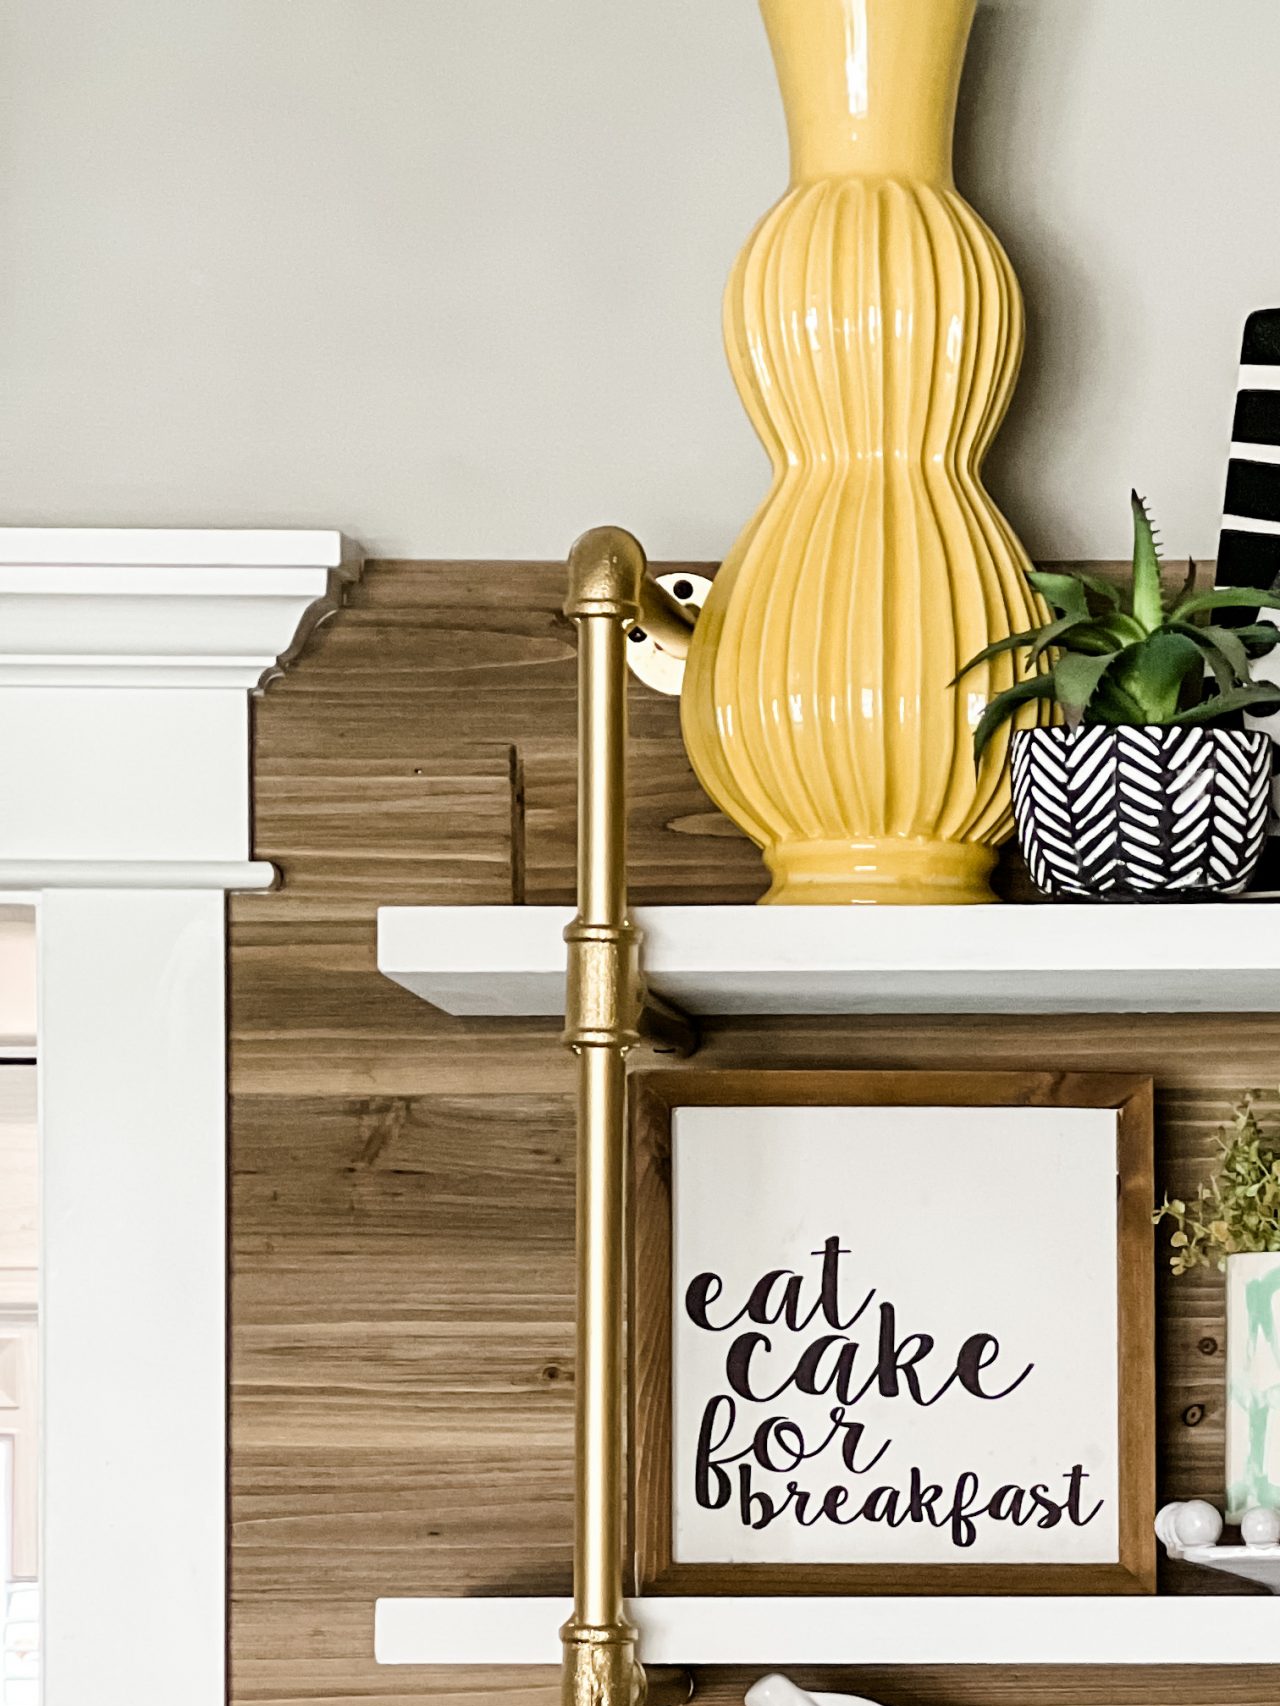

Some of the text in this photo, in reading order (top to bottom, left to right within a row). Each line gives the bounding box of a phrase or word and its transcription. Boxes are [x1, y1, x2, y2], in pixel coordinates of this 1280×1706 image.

[685, 1235, 877, 1332] eat
[725, 1301, 1035, 1407] cake
[694, 1394, 893, 1510] for
[738, 1463, 1105, 1548] breakfast
